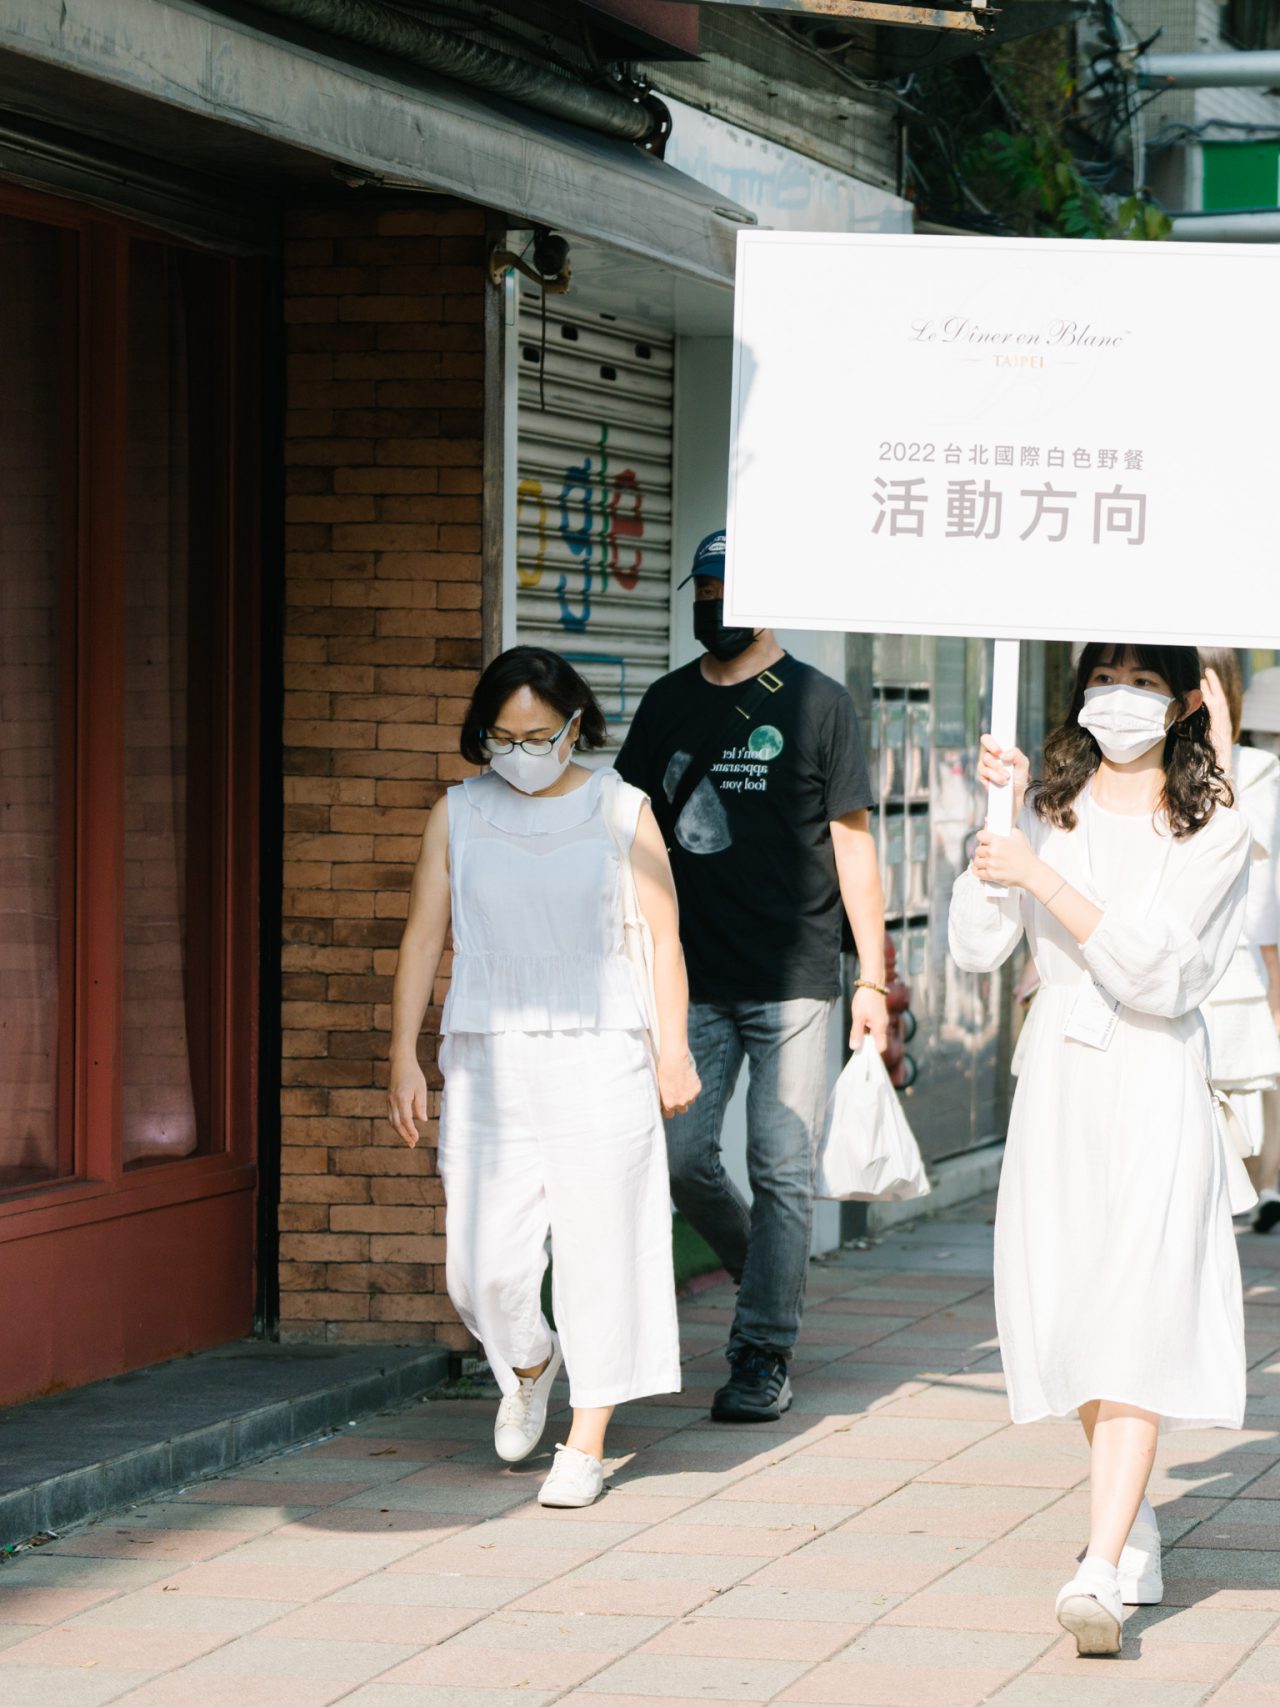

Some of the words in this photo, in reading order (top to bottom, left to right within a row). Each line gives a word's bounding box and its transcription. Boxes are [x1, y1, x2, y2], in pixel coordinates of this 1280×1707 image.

[910, 319, 937, 343] Le
[1016, 334, 1040, 345] en
[993, 354, 1045, 369] TAIPEI
[879, 441, 936, 463] 2022
[944, 442, 1144, 471] 台北國際白色野餐
[871, 475, 1147, 546] 活動方向
